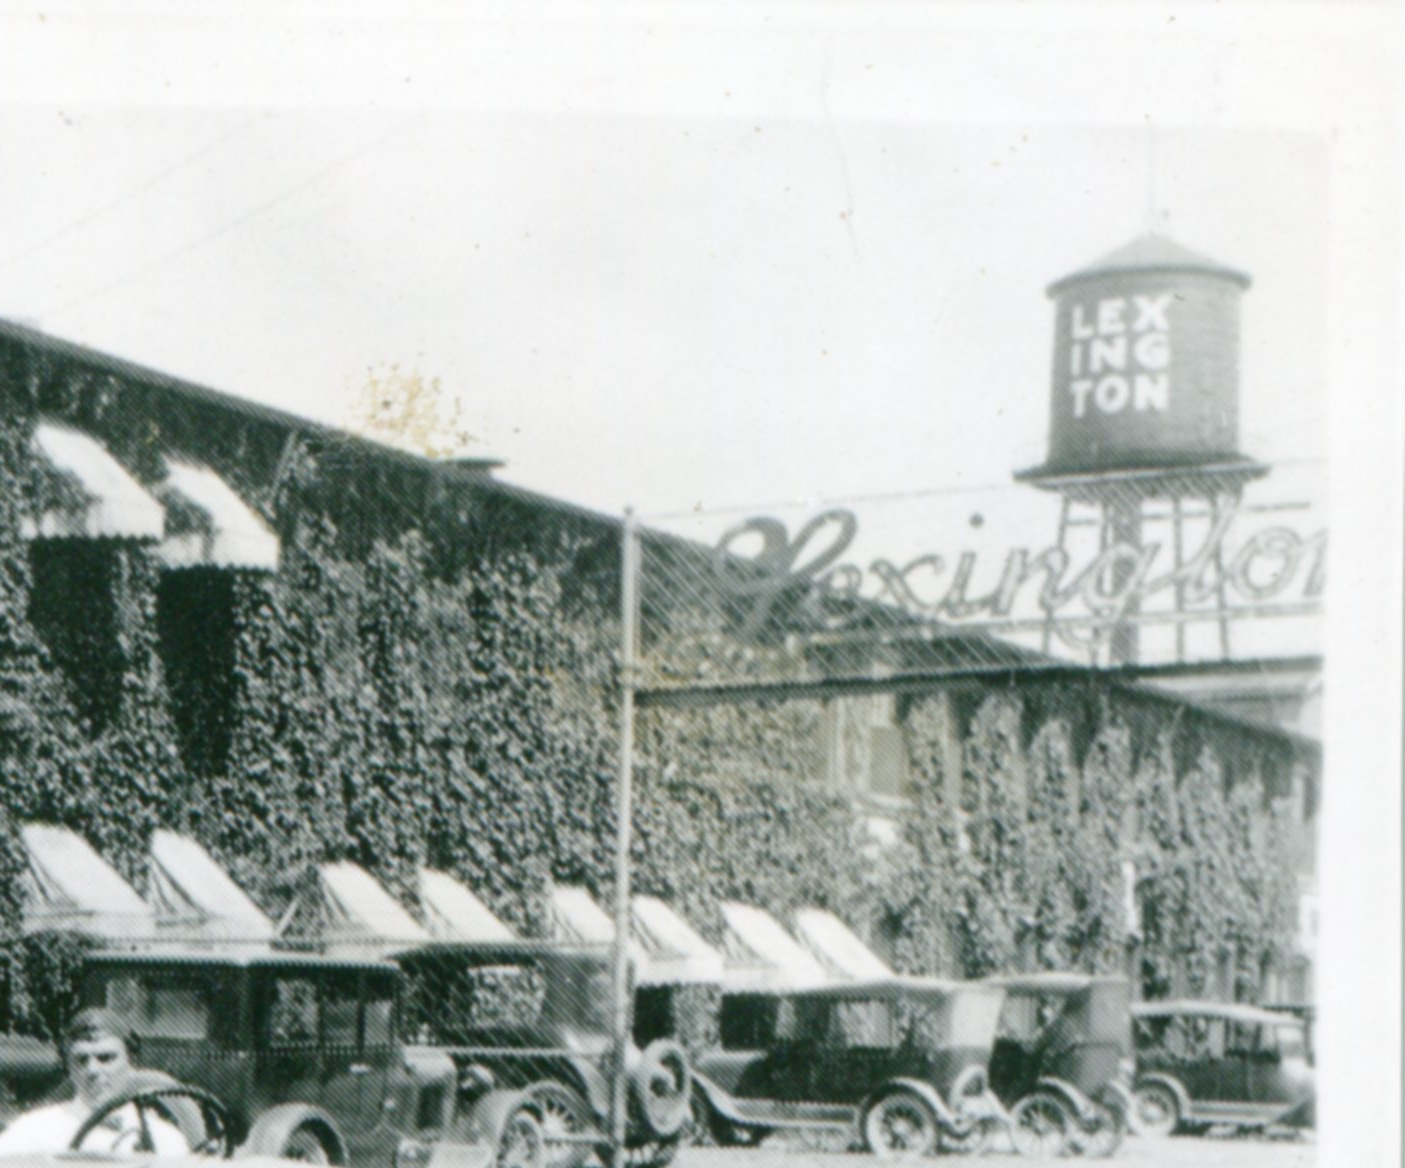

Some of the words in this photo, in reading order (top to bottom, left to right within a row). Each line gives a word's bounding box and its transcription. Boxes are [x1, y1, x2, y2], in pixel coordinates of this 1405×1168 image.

[1071, 295, 1170, 340] LEX
[1070, 333, 1170, 376] ING
[1070, 374, 1170, 418] TON
